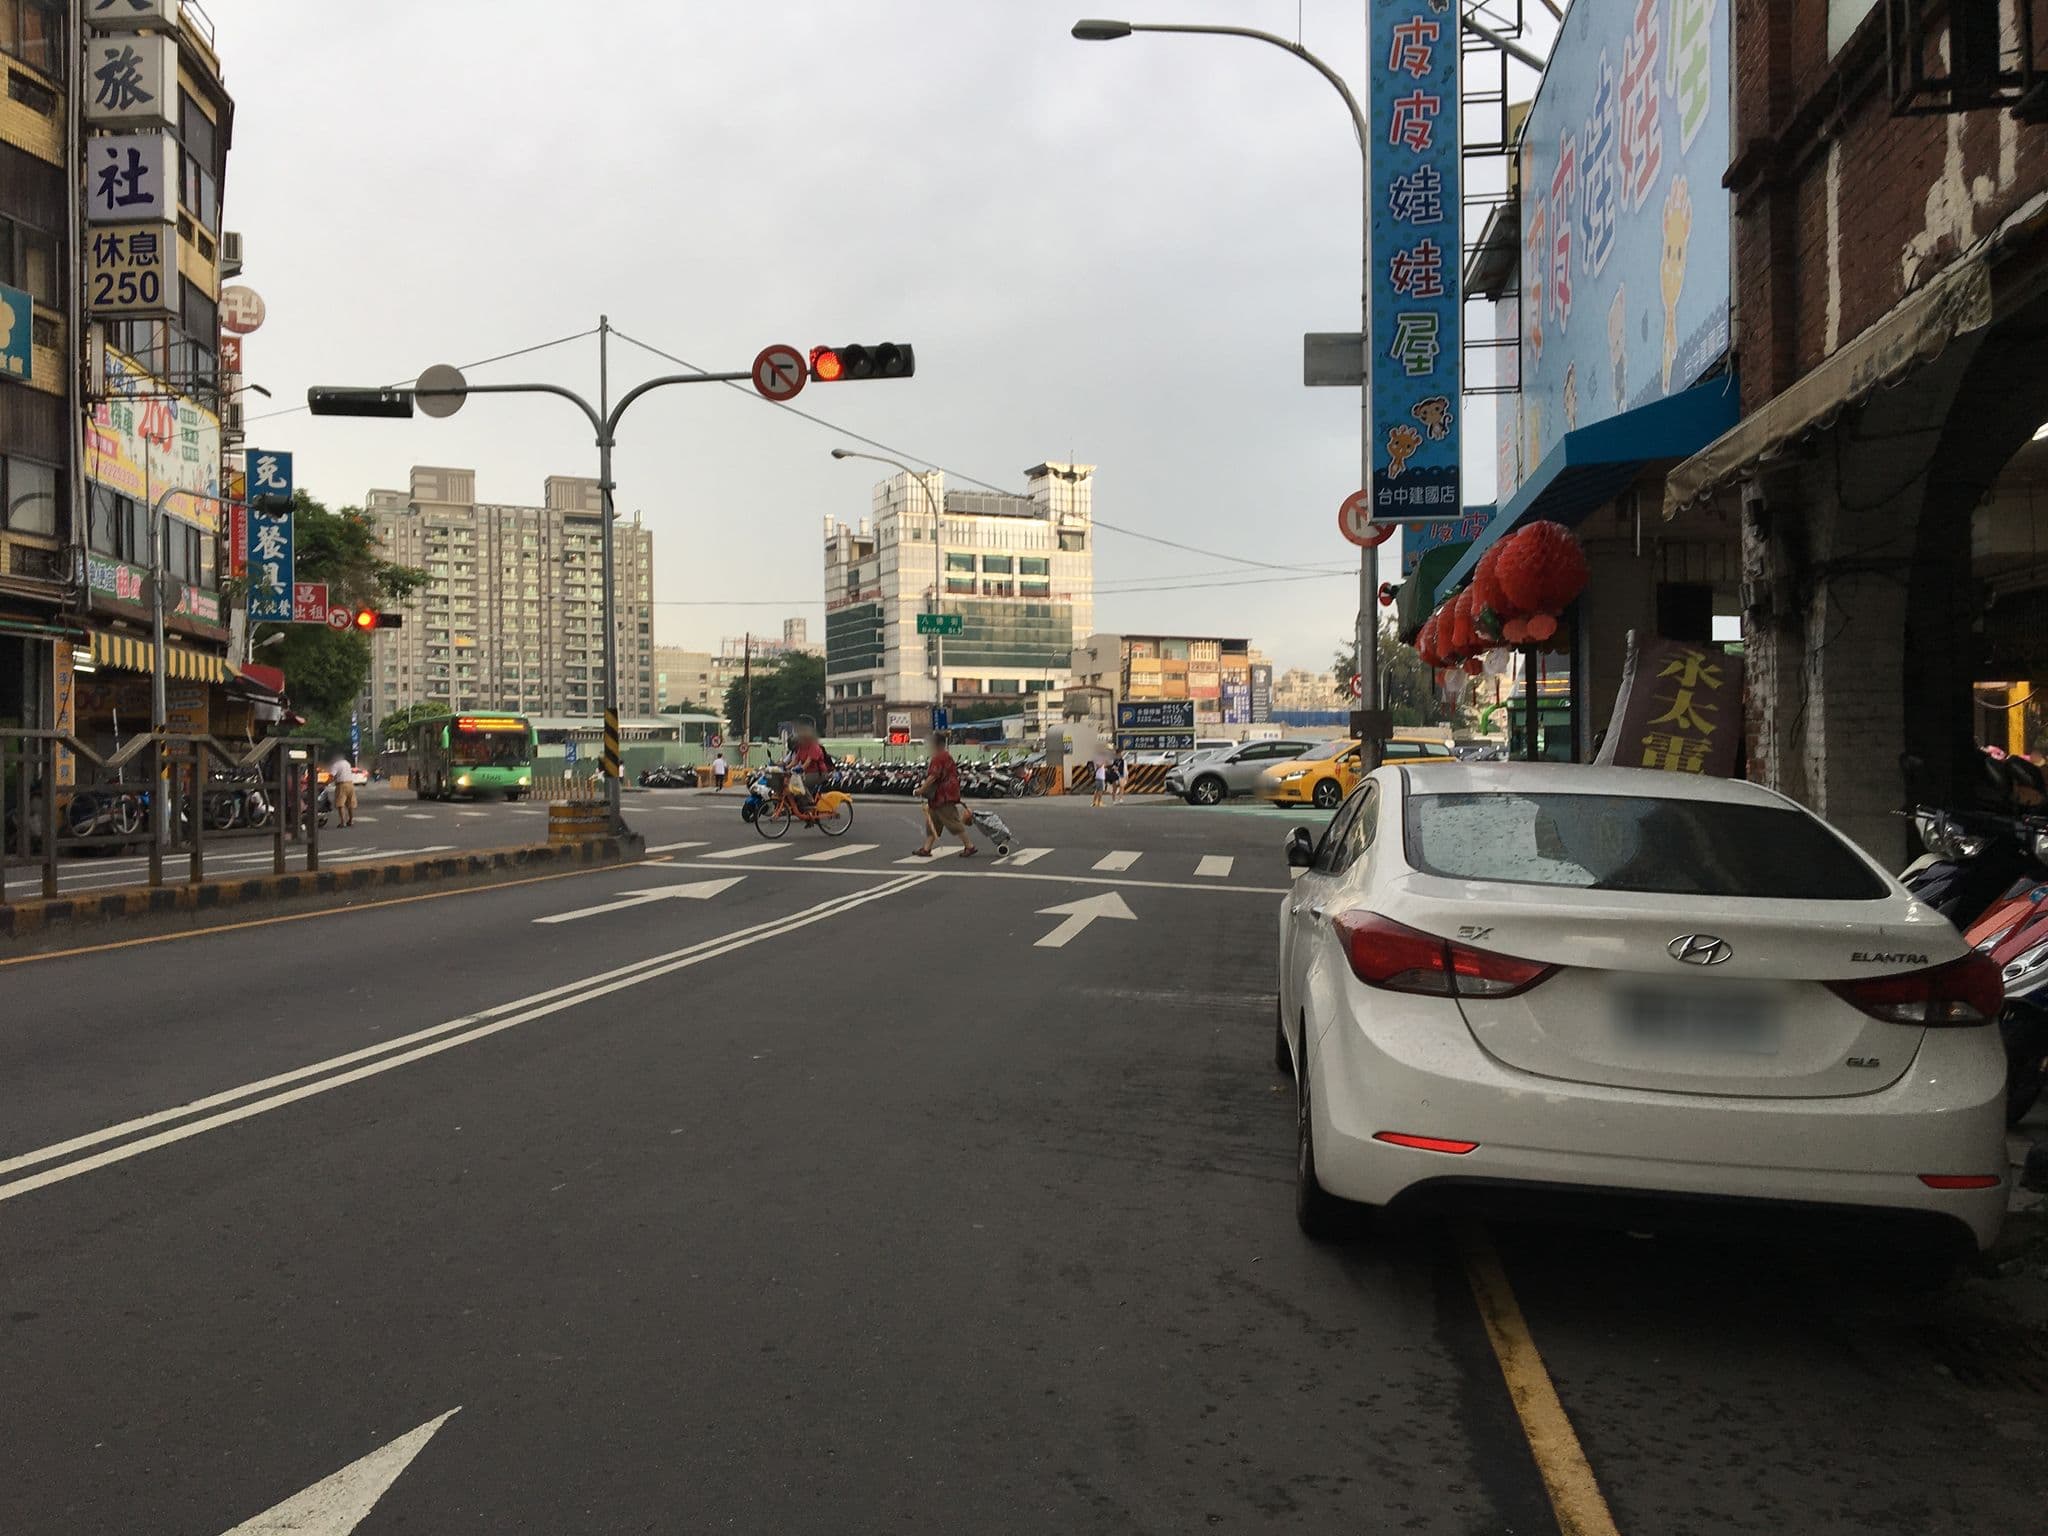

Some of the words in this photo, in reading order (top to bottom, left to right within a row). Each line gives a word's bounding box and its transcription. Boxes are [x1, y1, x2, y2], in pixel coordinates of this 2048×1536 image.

[93, 0, 155, 210] 旅社
[1389, 15, 1443, 376] 皮皮娃娃屋
[93, 232, 159, 267] 休息
[94, 271, 159, 305] 250
[1378, 486, 1456, 506] 台中建國店
[1850, 953, 1928, 964] ELANTRA
